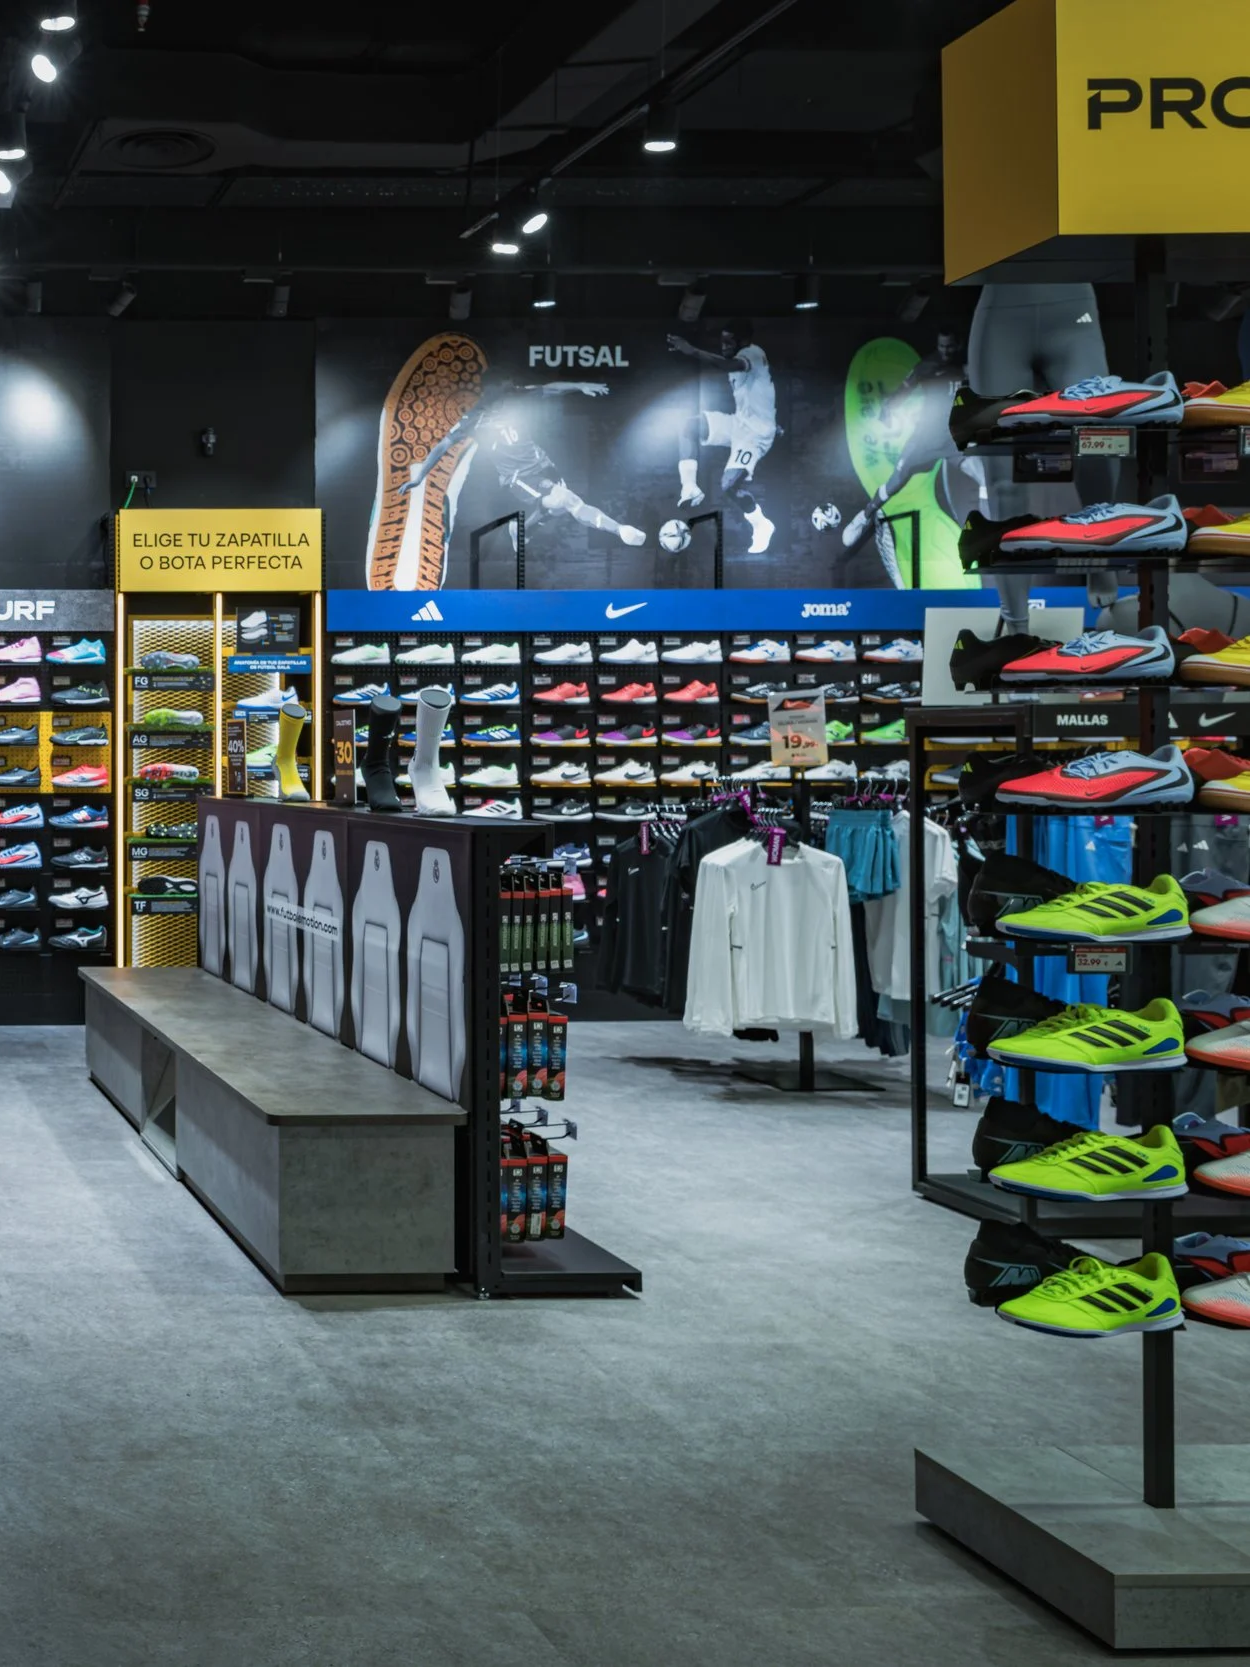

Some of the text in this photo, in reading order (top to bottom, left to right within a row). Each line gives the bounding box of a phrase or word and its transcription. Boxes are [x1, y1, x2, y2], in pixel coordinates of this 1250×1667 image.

[529, 345, 630, 368] FUTSAL
[734, 449, 753, 466] 10
[133, 533, 311, 548] ELIGE TU ZAPATILLA
[139, 555, 303, 570] O BOTA PERFECTA
[134, 676, 148, 685] FG
[1056, 714, 1109, 726] MALLAS
[132, 734, 148, 743] AG
[134, 788, 149, 797] SG
[132, 847, 148, 856] MG
[134, 901, 146, 910] TF
